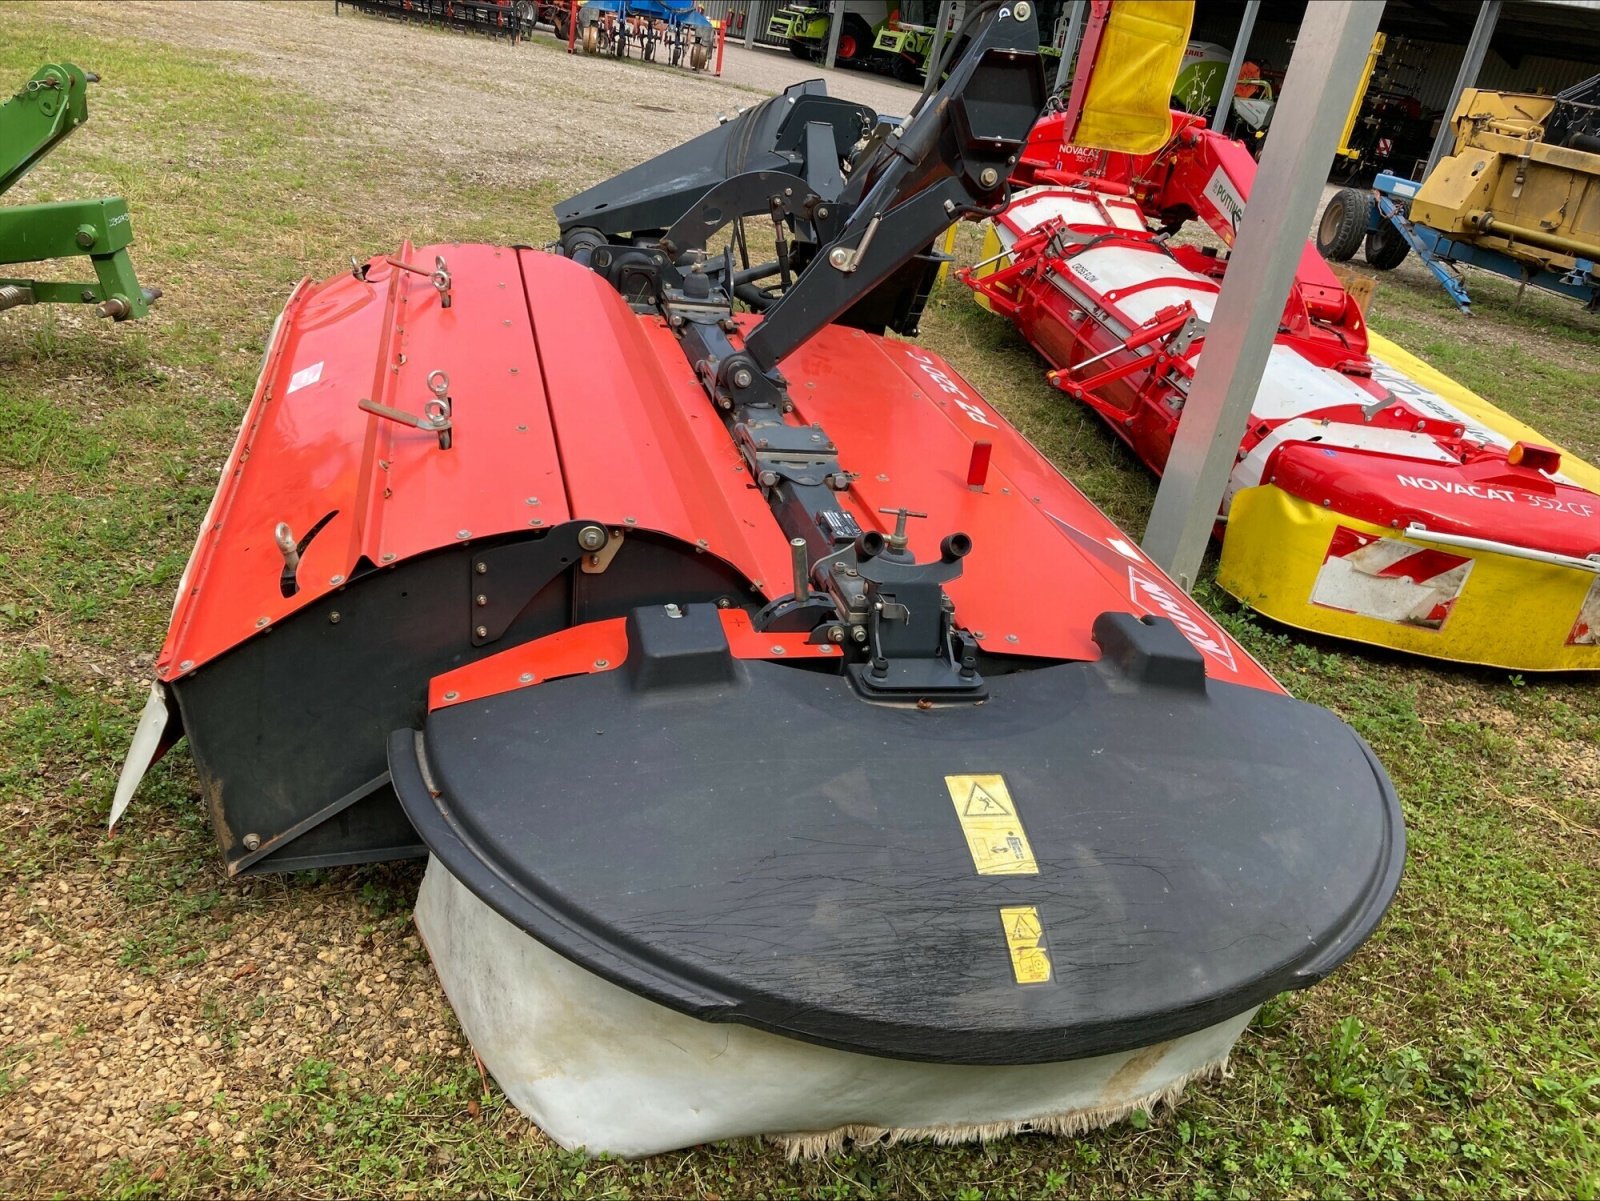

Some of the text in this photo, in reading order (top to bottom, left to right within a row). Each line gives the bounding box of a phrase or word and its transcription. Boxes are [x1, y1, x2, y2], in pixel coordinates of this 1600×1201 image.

[1396, 474, 1594, 518] NOVACAT 352CF
[1132, 576, 1230, 658] KUHN
